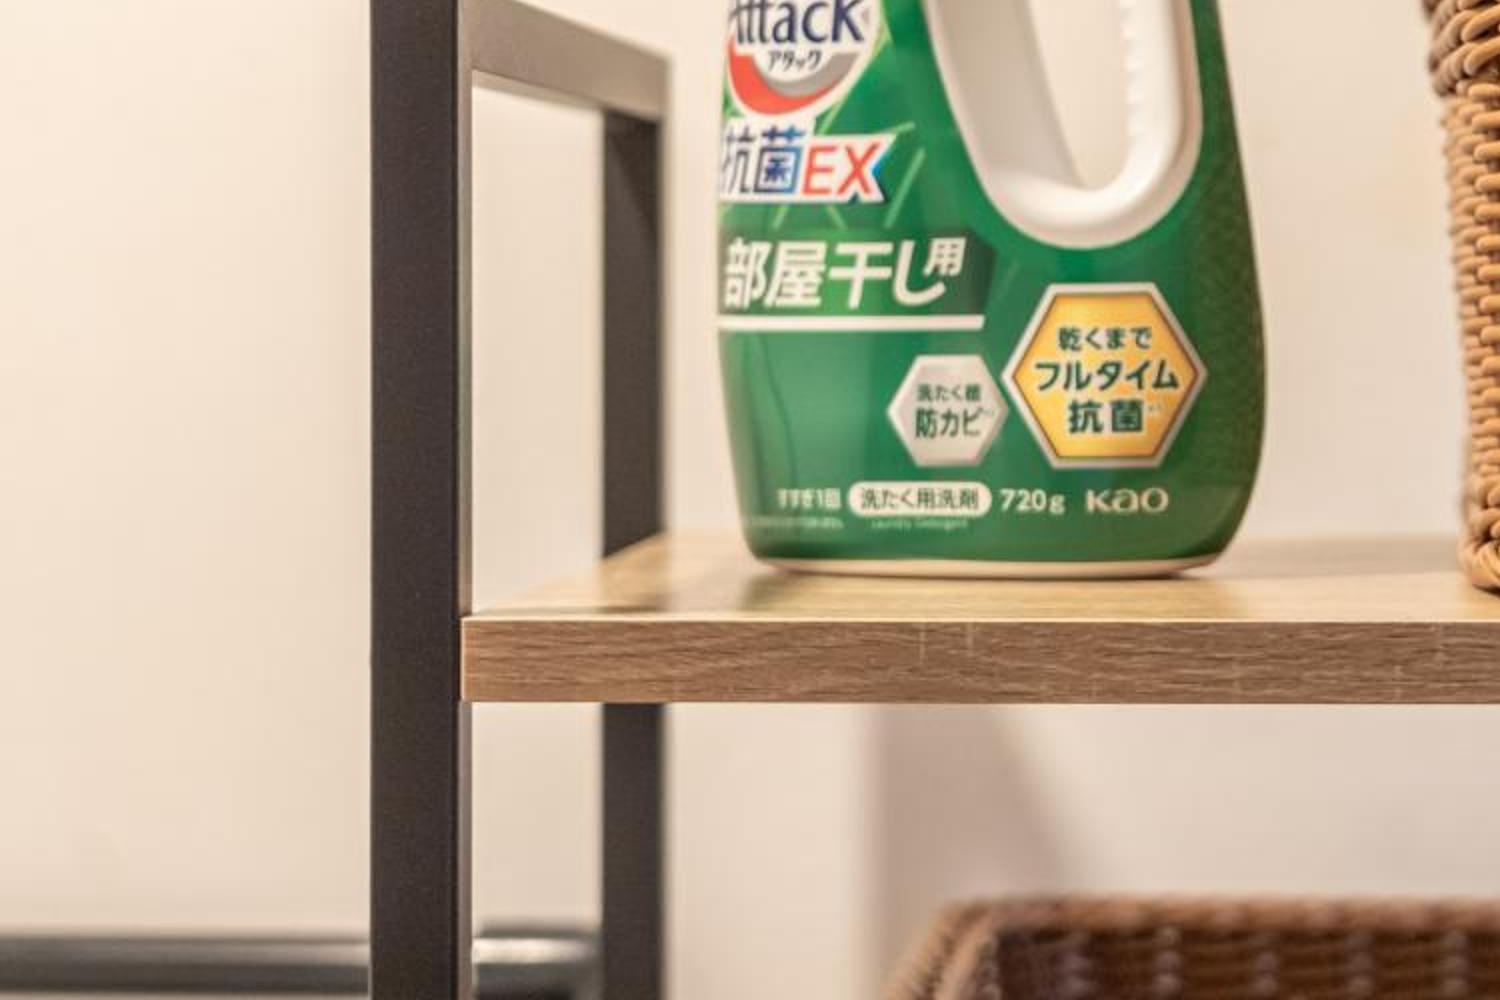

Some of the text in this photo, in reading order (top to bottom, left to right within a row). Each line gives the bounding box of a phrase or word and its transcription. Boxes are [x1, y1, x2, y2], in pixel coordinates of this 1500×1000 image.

[768, 49, 823, 73] アタック
[723, 236, 967, 310] 部屋干し用
[1058, 326, 1153, 351] 乾くまで
[1034, 359, 1180, 391] フルタイム
[915, 406, 984, 439] 防カビ
[860, 487, 980, 511] 洗たく用洗剤
[1000, 488, 1066, 515] 720g
